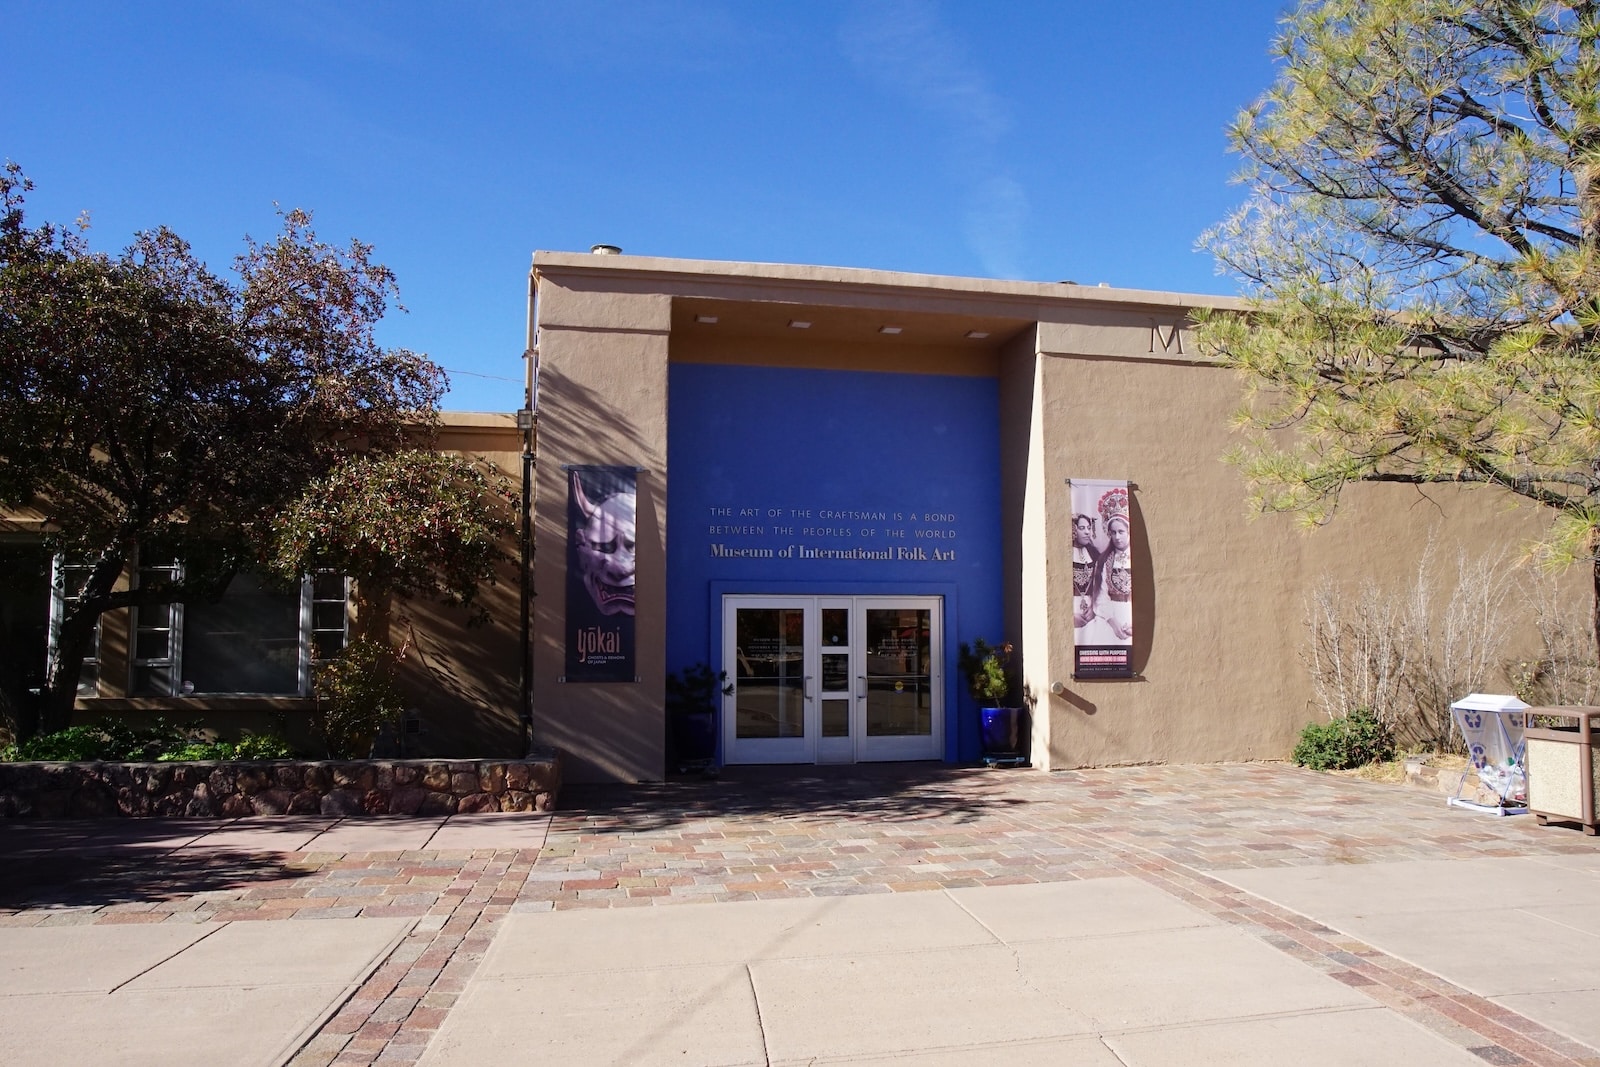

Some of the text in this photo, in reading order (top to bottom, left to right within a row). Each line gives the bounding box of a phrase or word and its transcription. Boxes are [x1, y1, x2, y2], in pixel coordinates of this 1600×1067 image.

[710, 507, 955, 522] THE ART OF THE CRAFTSMAN IS A BOND
[709, 525, 956, 539] BETWEEN THE PEOPLES OF THE WORLD
[710, 543, 956, 561] Museum of International Folk Art
[577, 626, 620, 663] yōkai
